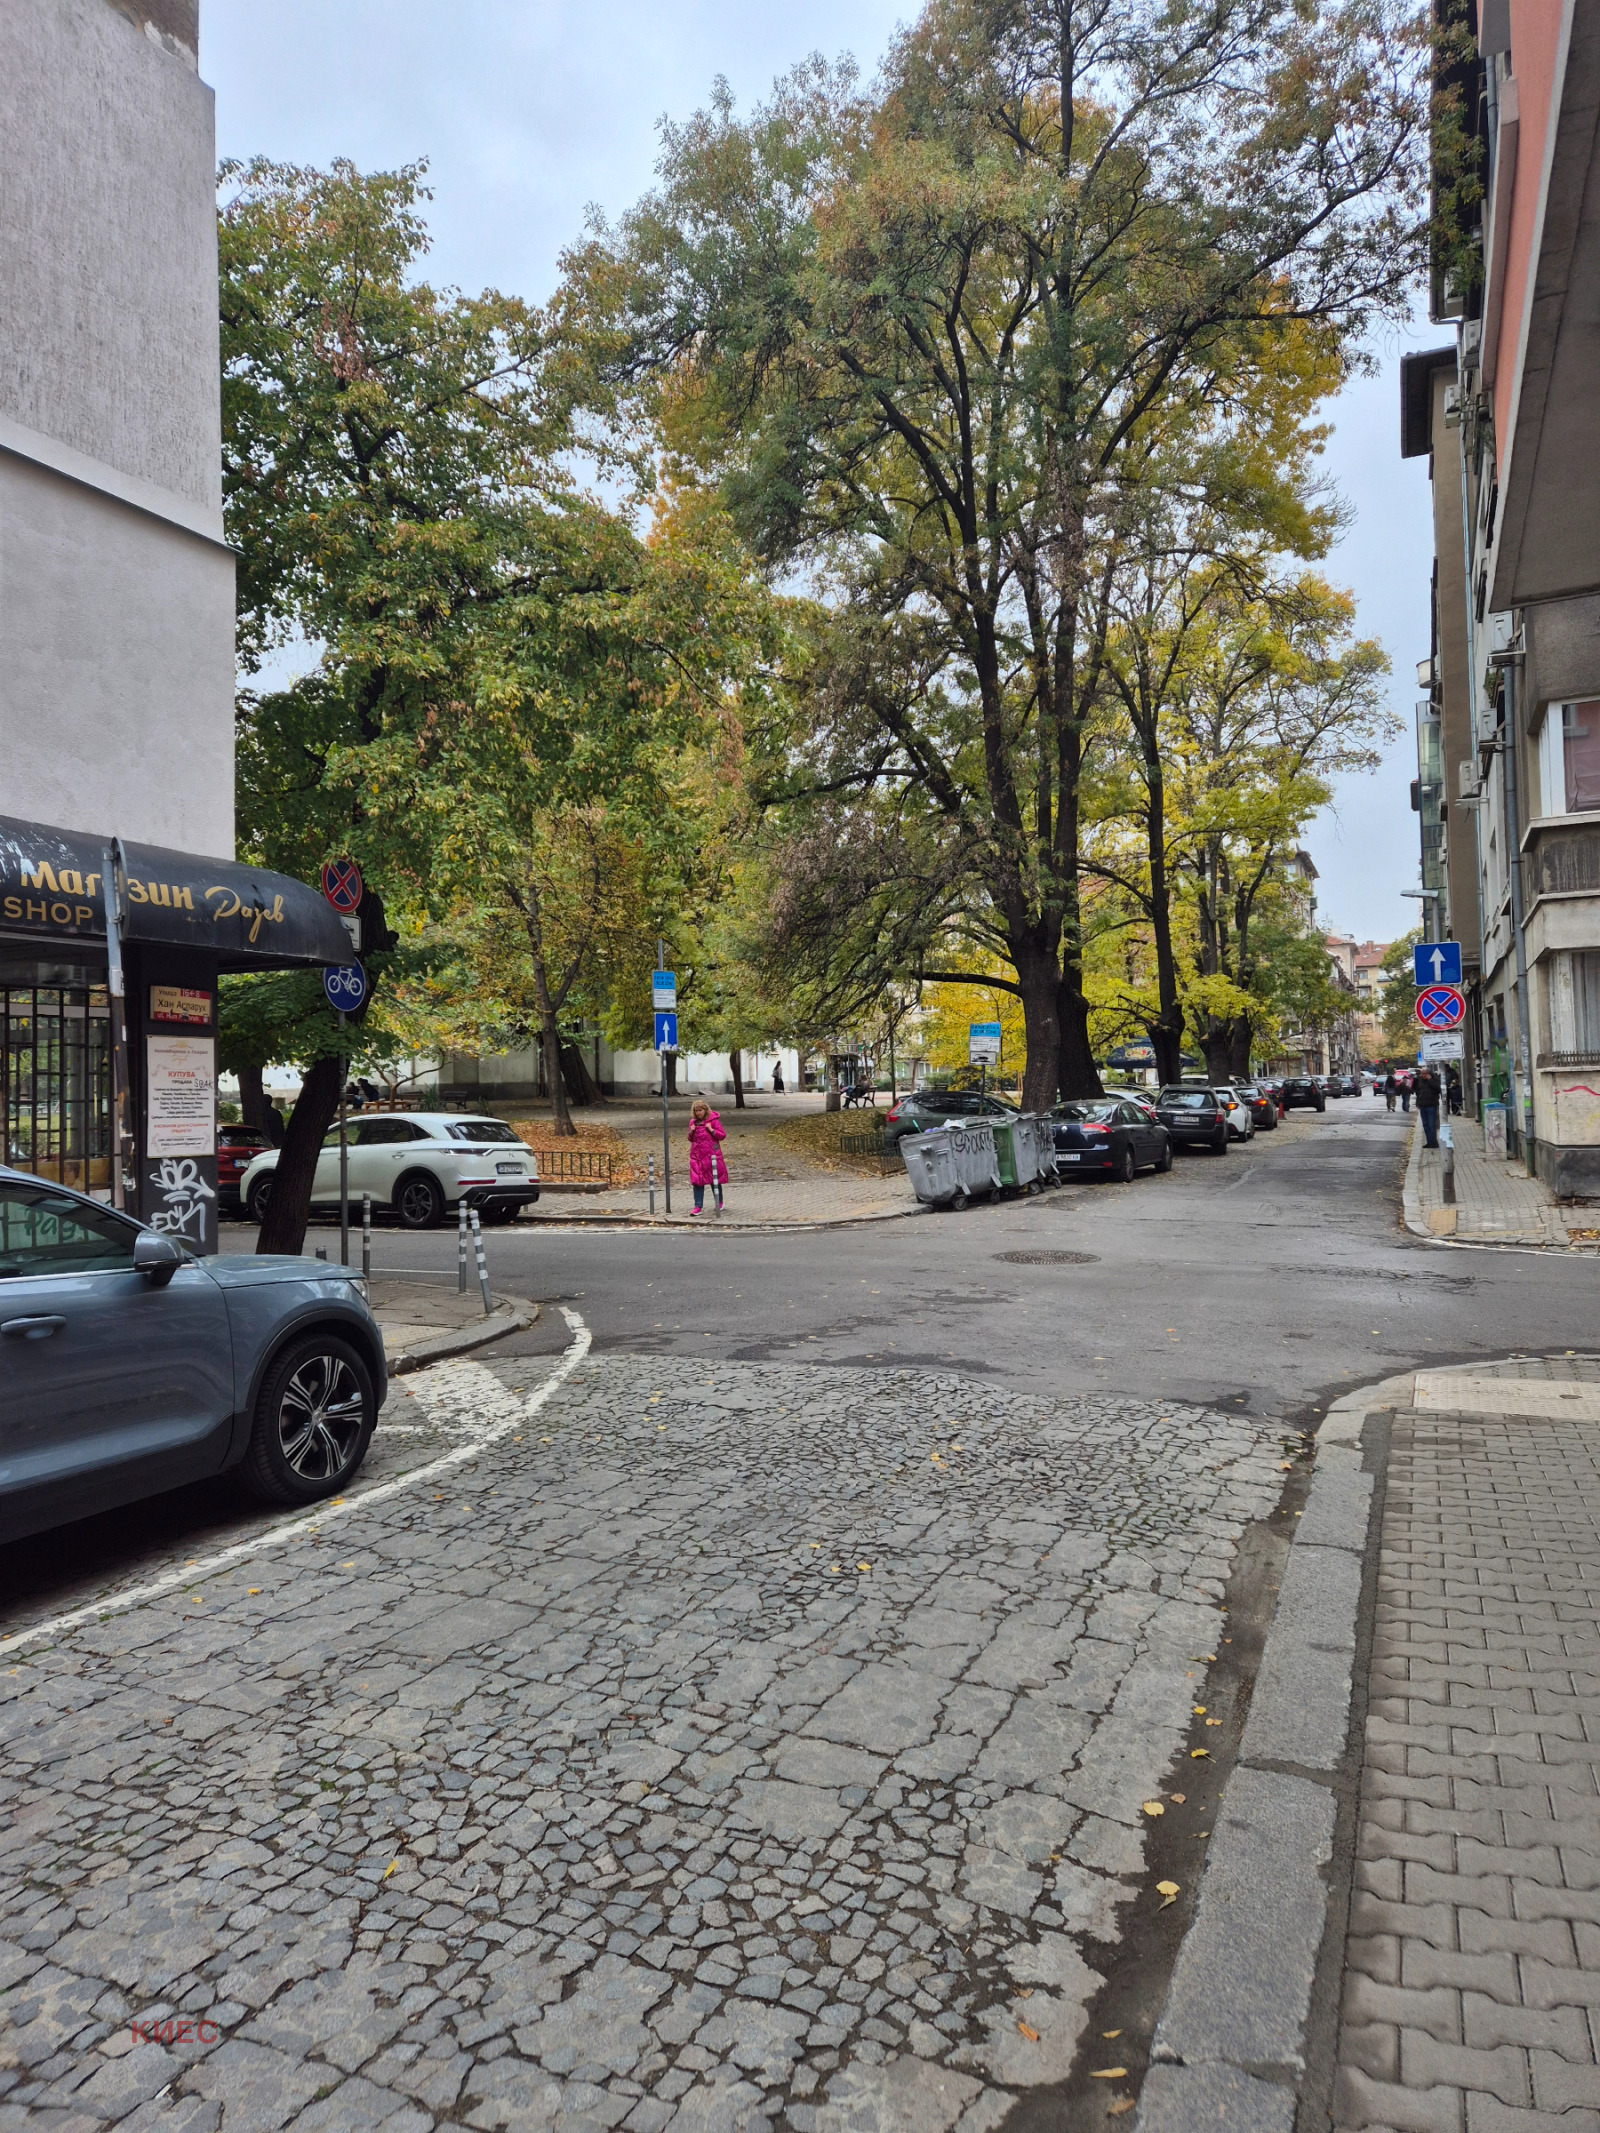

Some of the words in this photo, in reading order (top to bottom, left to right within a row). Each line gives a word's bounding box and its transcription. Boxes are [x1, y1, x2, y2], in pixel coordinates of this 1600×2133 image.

[21, 860, 195, 910] Магзин
[4, 896, 93, 926] SHOP
[158, 989, 177, 997] Улица
[158, 999, 175, 1008] Хан
[176, 1001, 207, 1013] Аспарух
